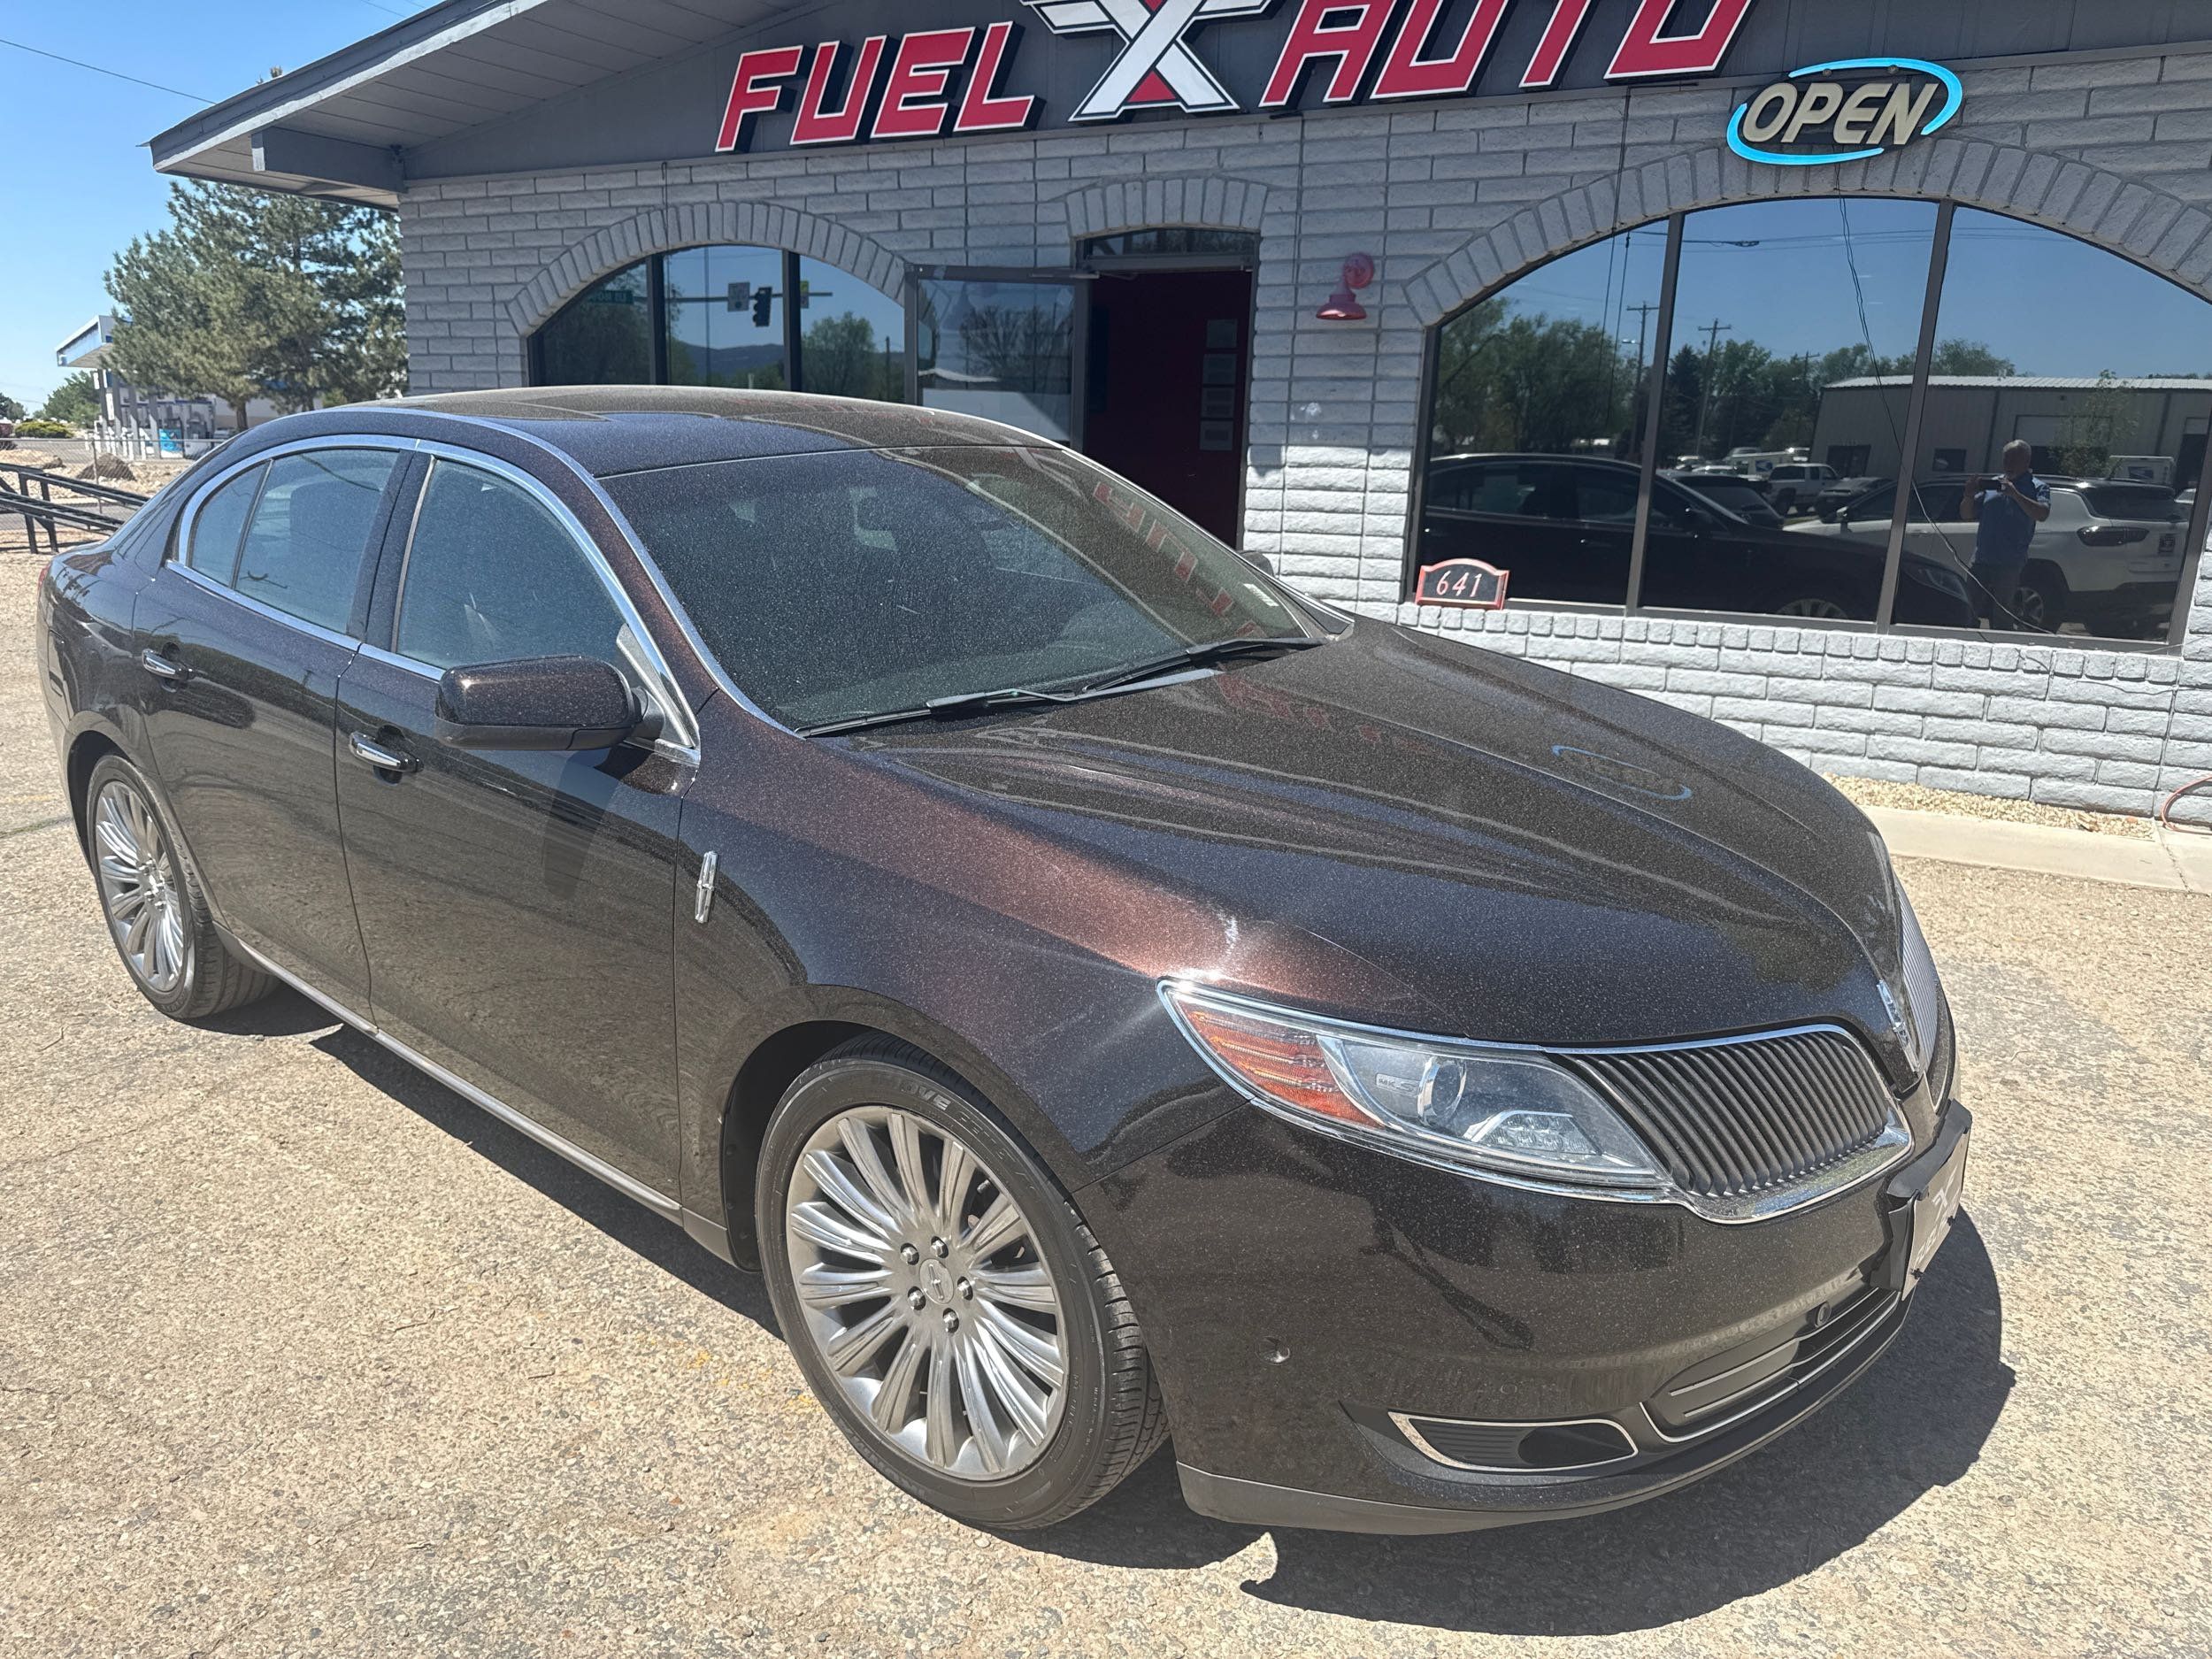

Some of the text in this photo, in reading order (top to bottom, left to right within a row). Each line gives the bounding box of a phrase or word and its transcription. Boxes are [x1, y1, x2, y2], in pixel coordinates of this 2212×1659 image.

[715, 20, 1035, 153] FUEL
[1026, 0, 1276, 122] X
[1742, 82, 1939, 145] OPEN
[1435, 570, 1483, 597] 641
